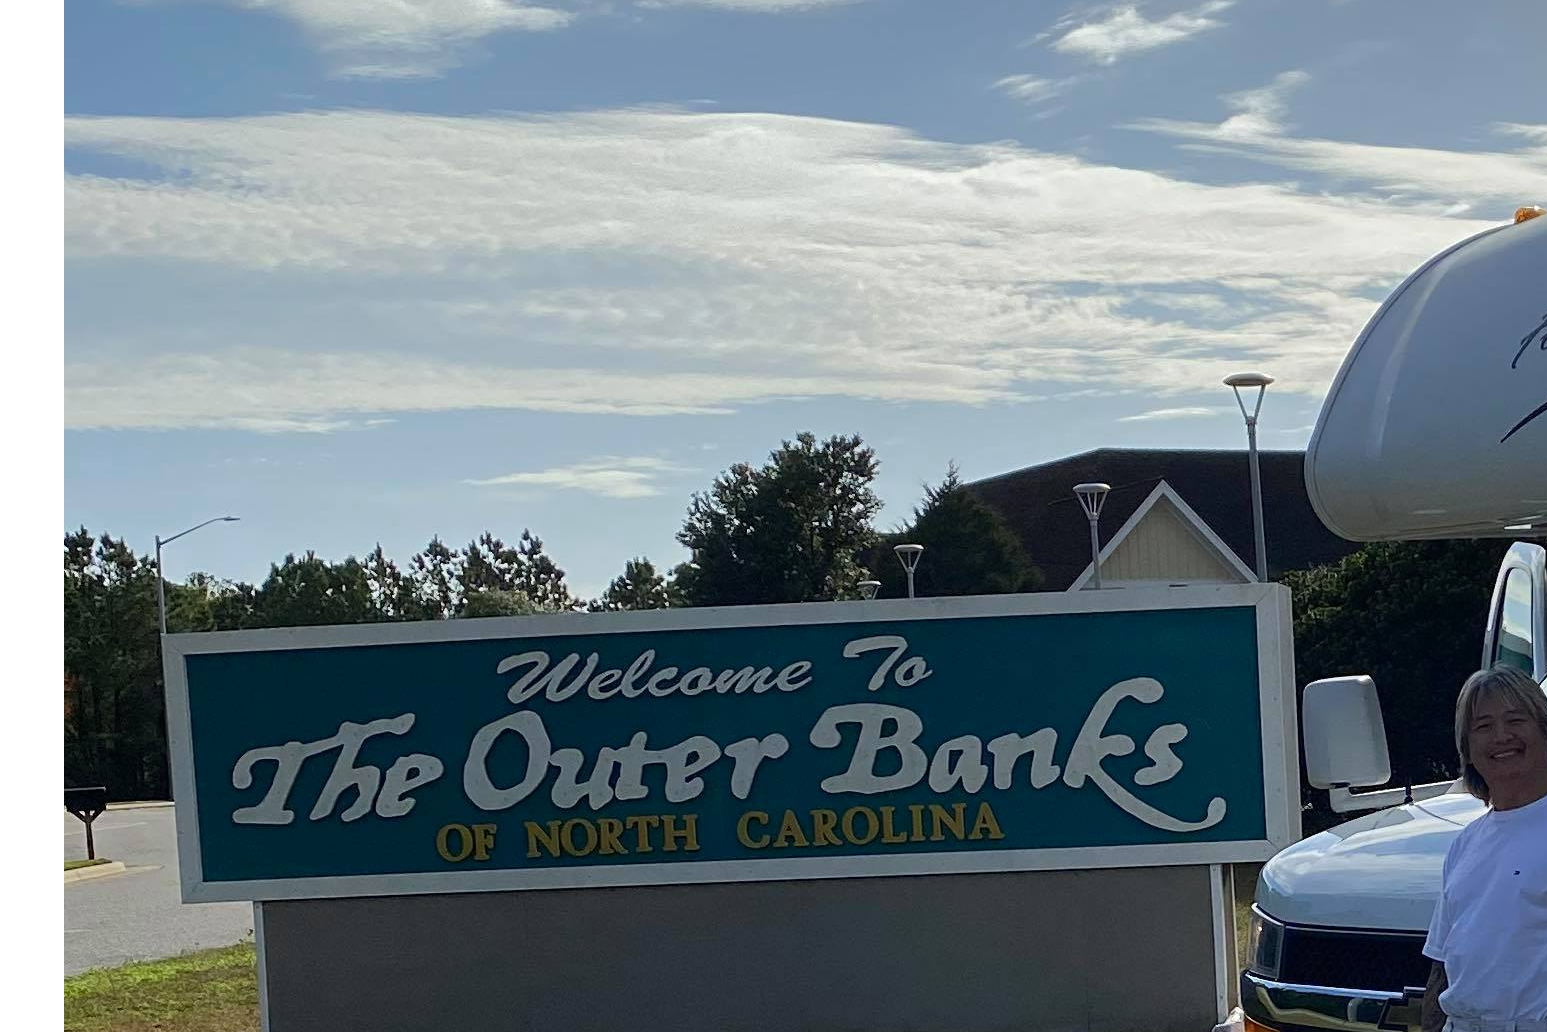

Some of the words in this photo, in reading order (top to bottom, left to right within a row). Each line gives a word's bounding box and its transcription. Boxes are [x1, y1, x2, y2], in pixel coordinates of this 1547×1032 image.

[496, 649, 813, 704] Welcome
[843, 635, 934, 692] To
[232, 712, 445, 825] The
[462, 710, 788, 811] Outer
[809, 677, 1228, 833] Banks
[435, 823, 498, 863] OF
[525, 815, 700, 859] NORTH
[736, 802, 1004, 849] CAROLINA
